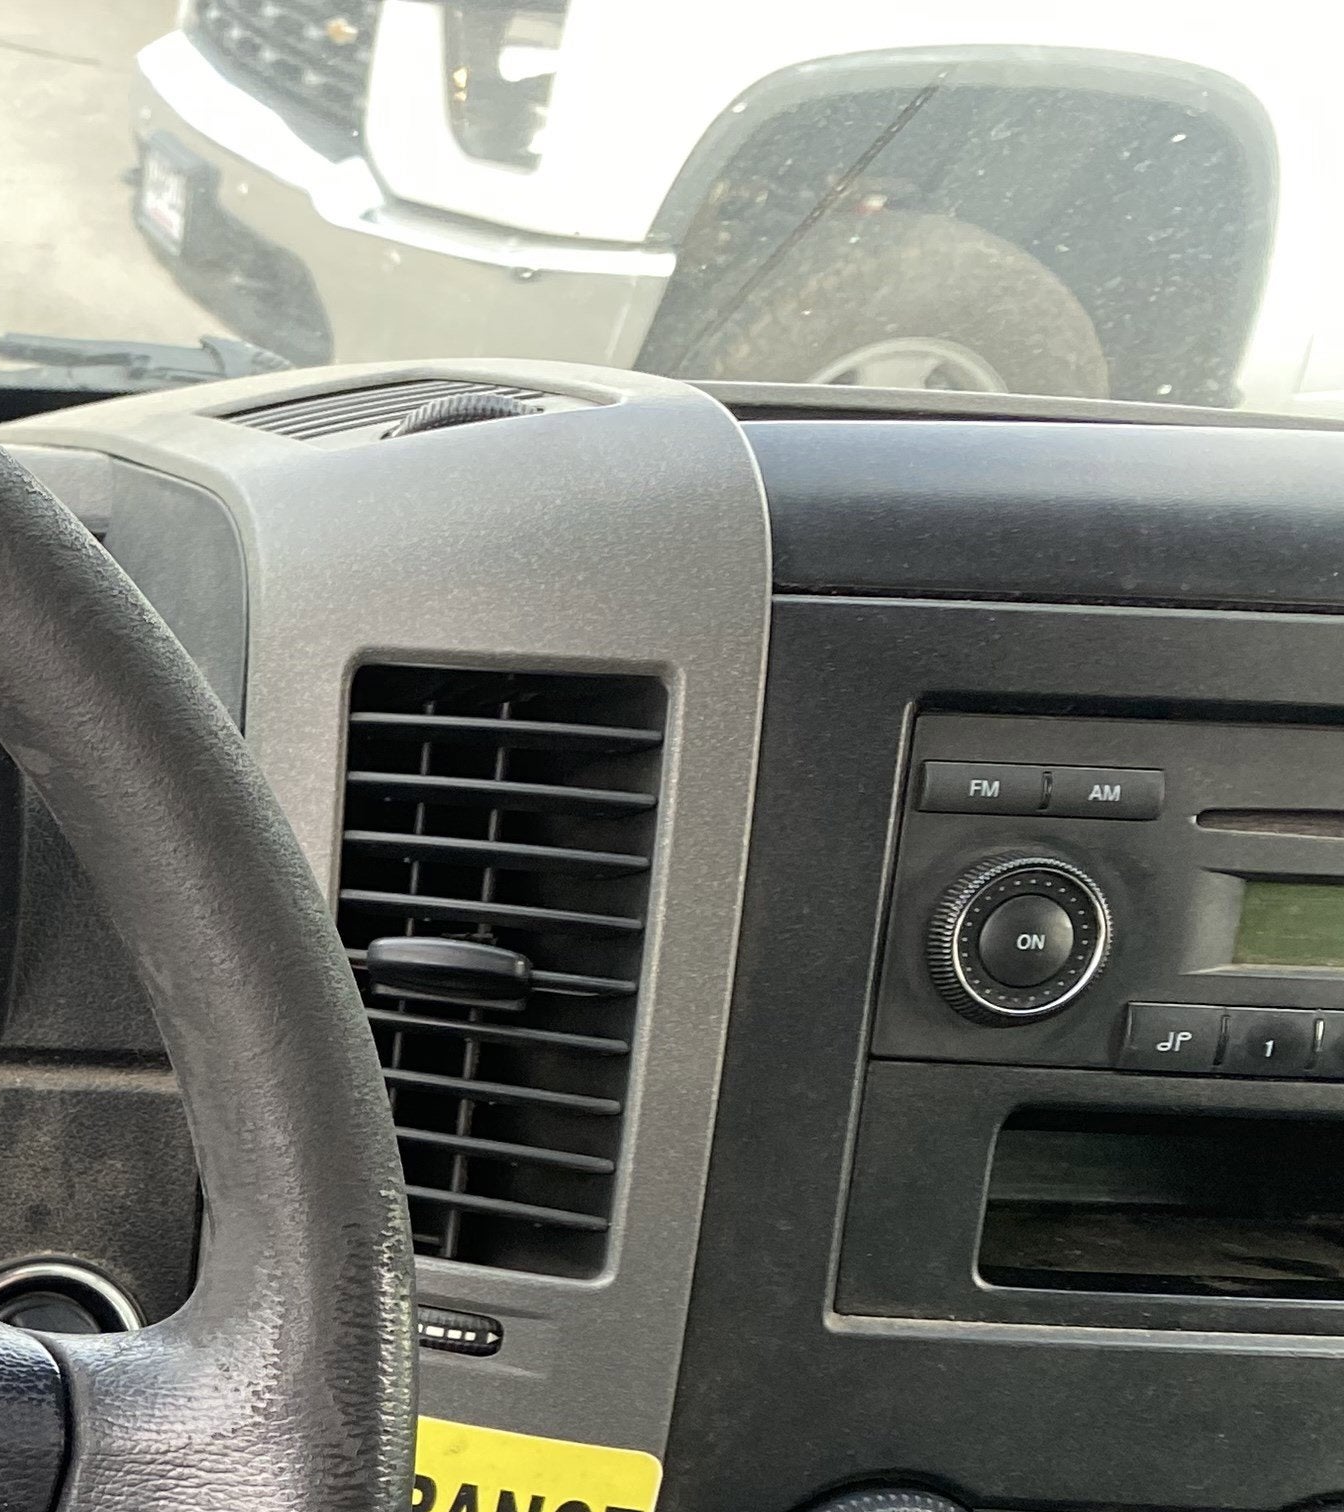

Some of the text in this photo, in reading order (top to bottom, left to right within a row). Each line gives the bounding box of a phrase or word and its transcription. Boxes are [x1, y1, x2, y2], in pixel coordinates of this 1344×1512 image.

[969, 780, 1000, 798] FM
[1088, 784, 1122, 802] AM
[1016, 934, 1046, 951] ON
[1263, 1040, 1275, 1058] 1
